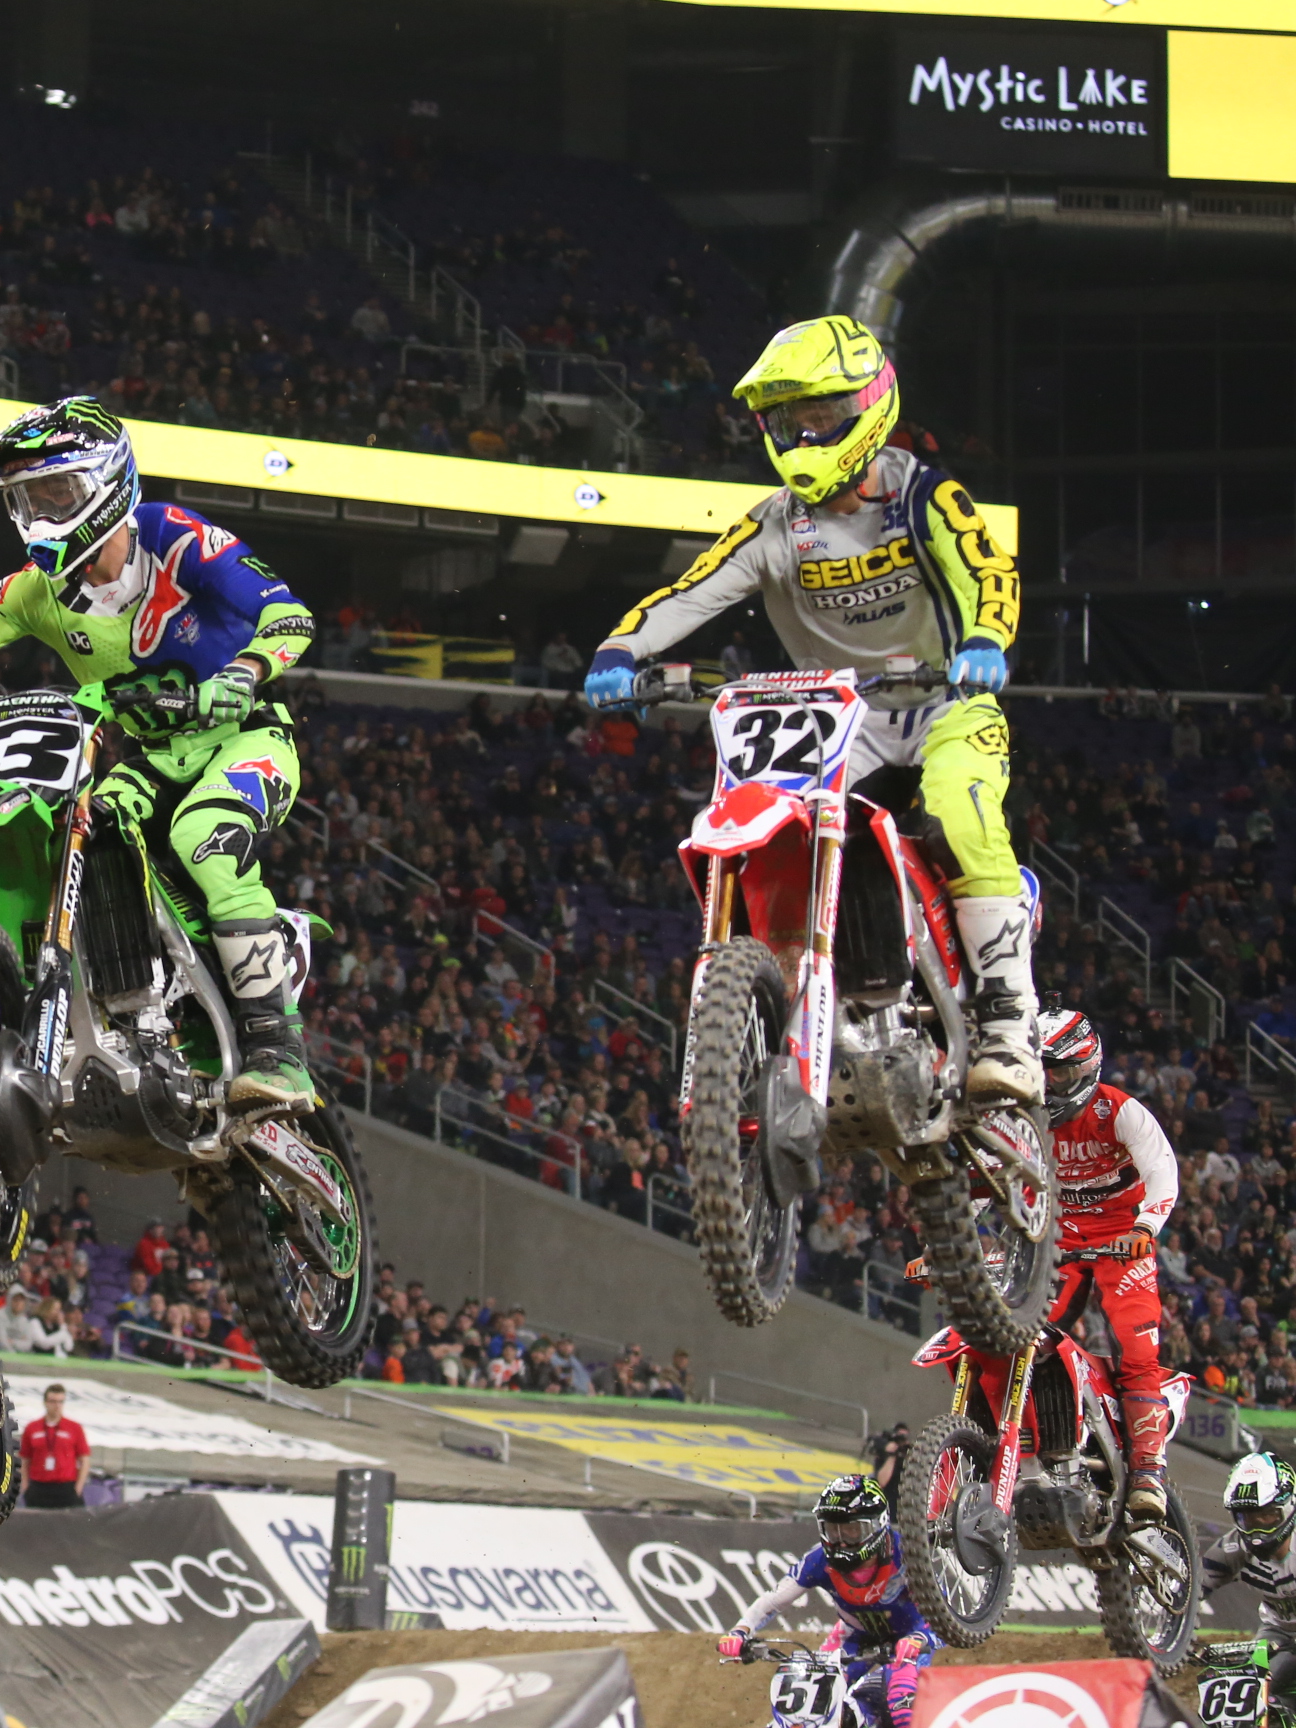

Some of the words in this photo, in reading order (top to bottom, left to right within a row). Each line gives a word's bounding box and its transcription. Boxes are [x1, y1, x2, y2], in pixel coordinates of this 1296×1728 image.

[909, 57, 1045, 112] Mystic
[1000, 116, 1072, 133] CASINO
[1088, 118, 1148, 136] HOTEL
[838, 414, 887, 472] GEICO
[91, 485, 132, 528] MONSTER
[813, 574, 922, 609] HONDA
[727, 709, 837, 780] 32
[37, 998, 50, 1048] CARRILLO
[50, 987, 71, 1079] DUNLOP
[814, 984, 827, 1068] DUNLOP
[1188, 1413, 1226, 1438] 136
[995, 1445, 1016, 1509] DUNLOP
[774, 1674, 837, 1716] 51
[1202, 1678, 1261, 1722] 69
